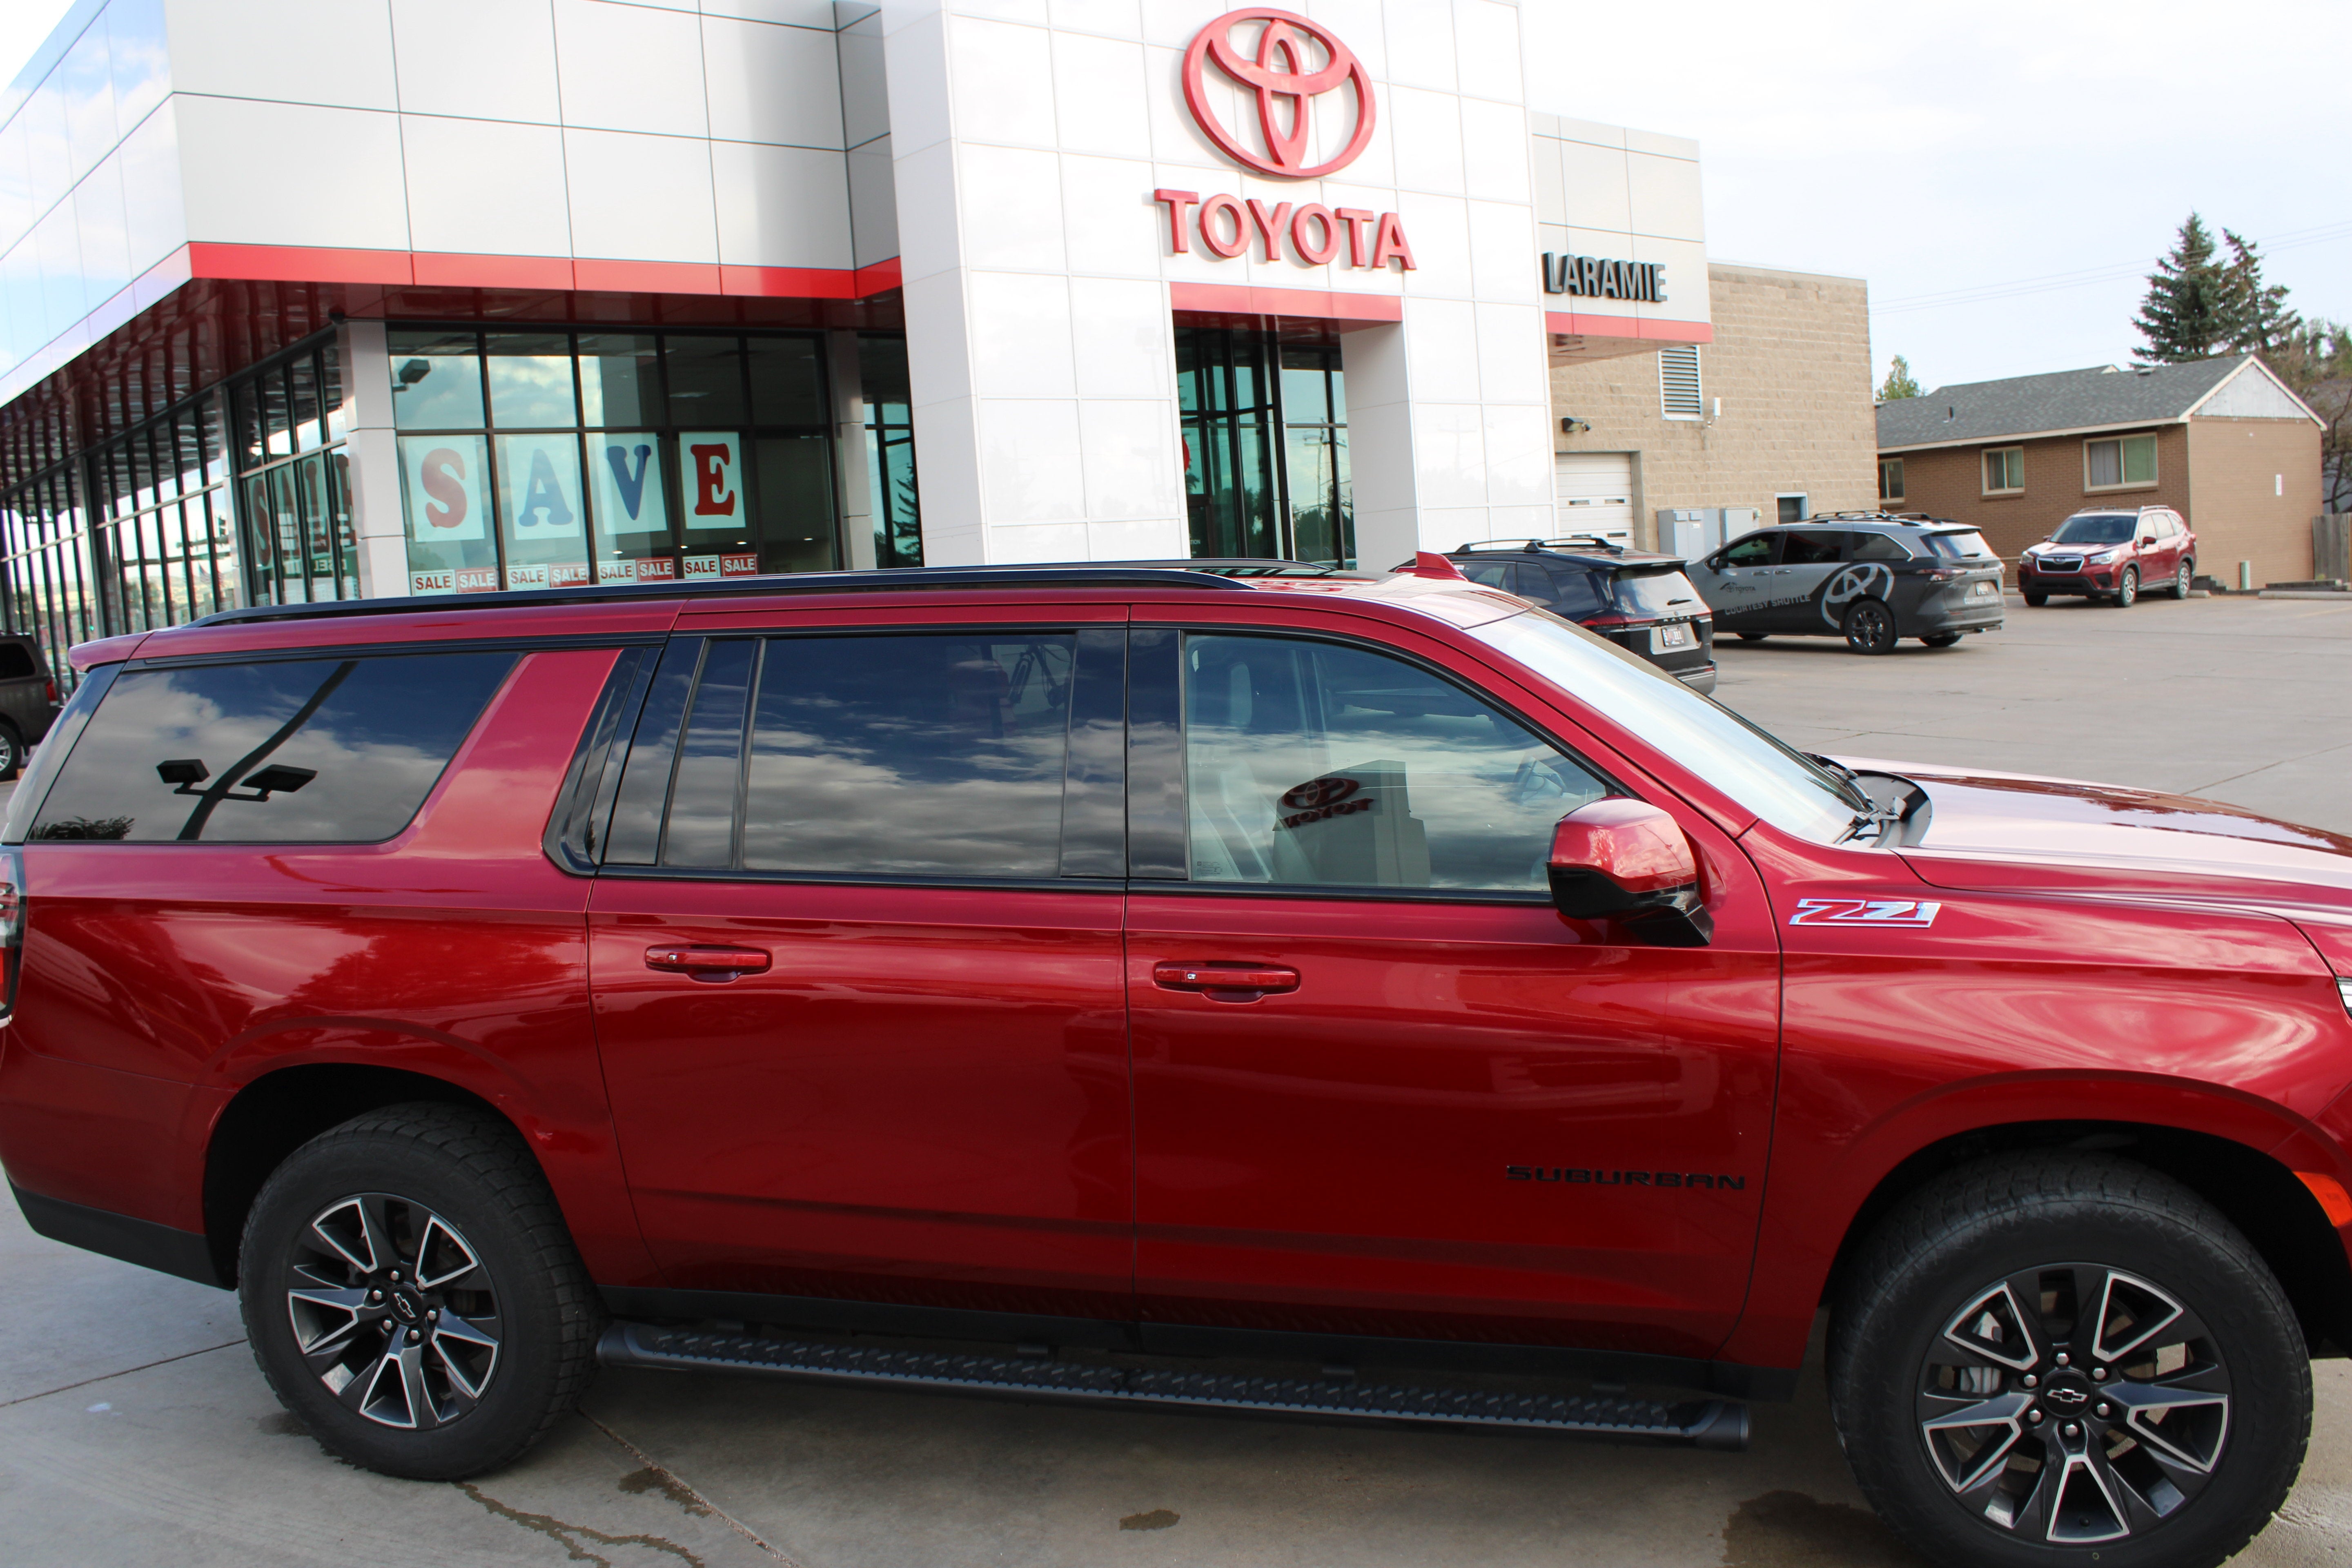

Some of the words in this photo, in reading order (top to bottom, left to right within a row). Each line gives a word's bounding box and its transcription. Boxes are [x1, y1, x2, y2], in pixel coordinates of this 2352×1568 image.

[1154, 189, 1417, 270] TOYOTA
[1542, 252, 1668, 303] LARAMIE
[421, 443, 735, 528] SAVE
[600, 566, 633, 579] SALE
[639, 562, 673, 577] SALE
[685, 560, 716, 574] SALE
[724, 558, 755, 572] SALE
[416, 575, 451, 590] SALE
[459, 572, 495, 588] SALE
[510, 569, 545, 584] SALE
[552, 568, 587, 582] SALE
[1724, 600, 1769, 615] COURTESY
[1771, 594, 1811, 607] SHUTTLE
[1789, 898, 1942, 928] Z71
[1506, 1165, 1746, 1190] SUBURBAN
